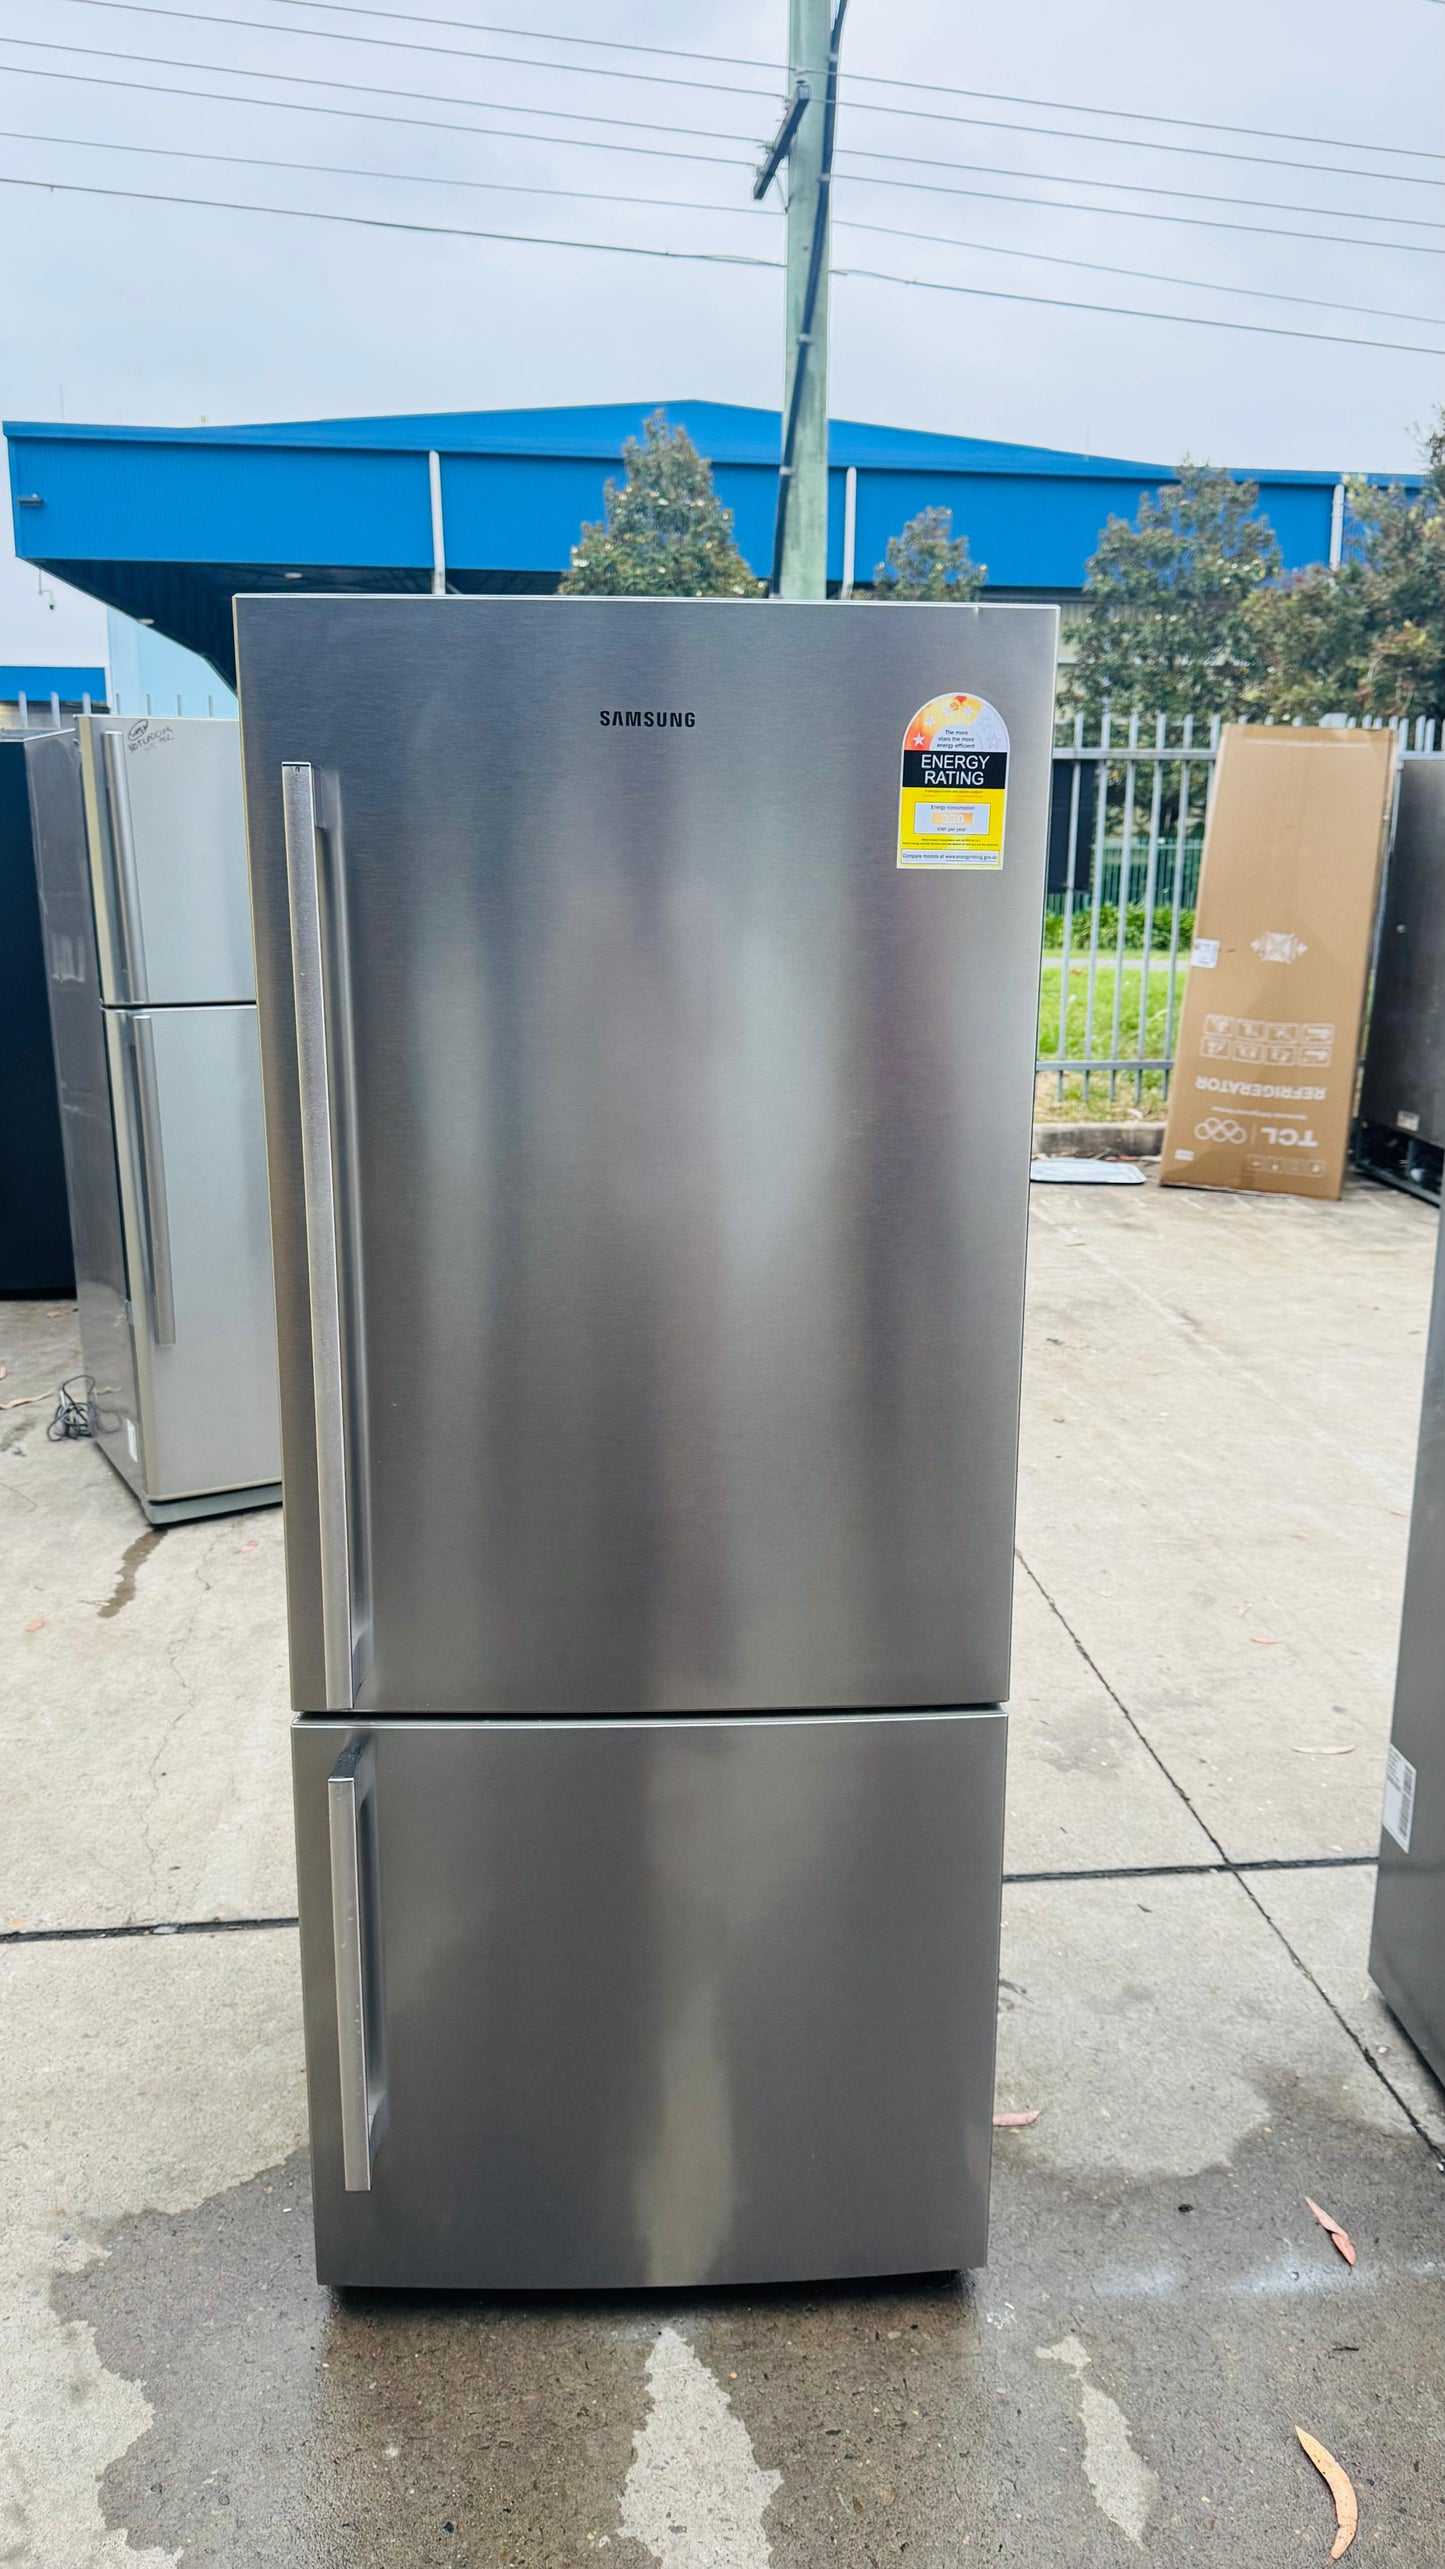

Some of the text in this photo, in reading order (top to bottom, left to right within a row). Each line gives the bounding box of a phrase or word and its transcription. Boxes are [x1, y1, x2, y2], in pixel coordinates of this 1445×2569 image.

[600, 711, 696, 728] SAMSUNG
[921, 754, 990, 770] ENERGY
[924, 771, 984, 786] RATING
[1195, 1075, 1326, 1100] REFRIGERATOR
[1260, 1126, 1319, 1147] TCL
